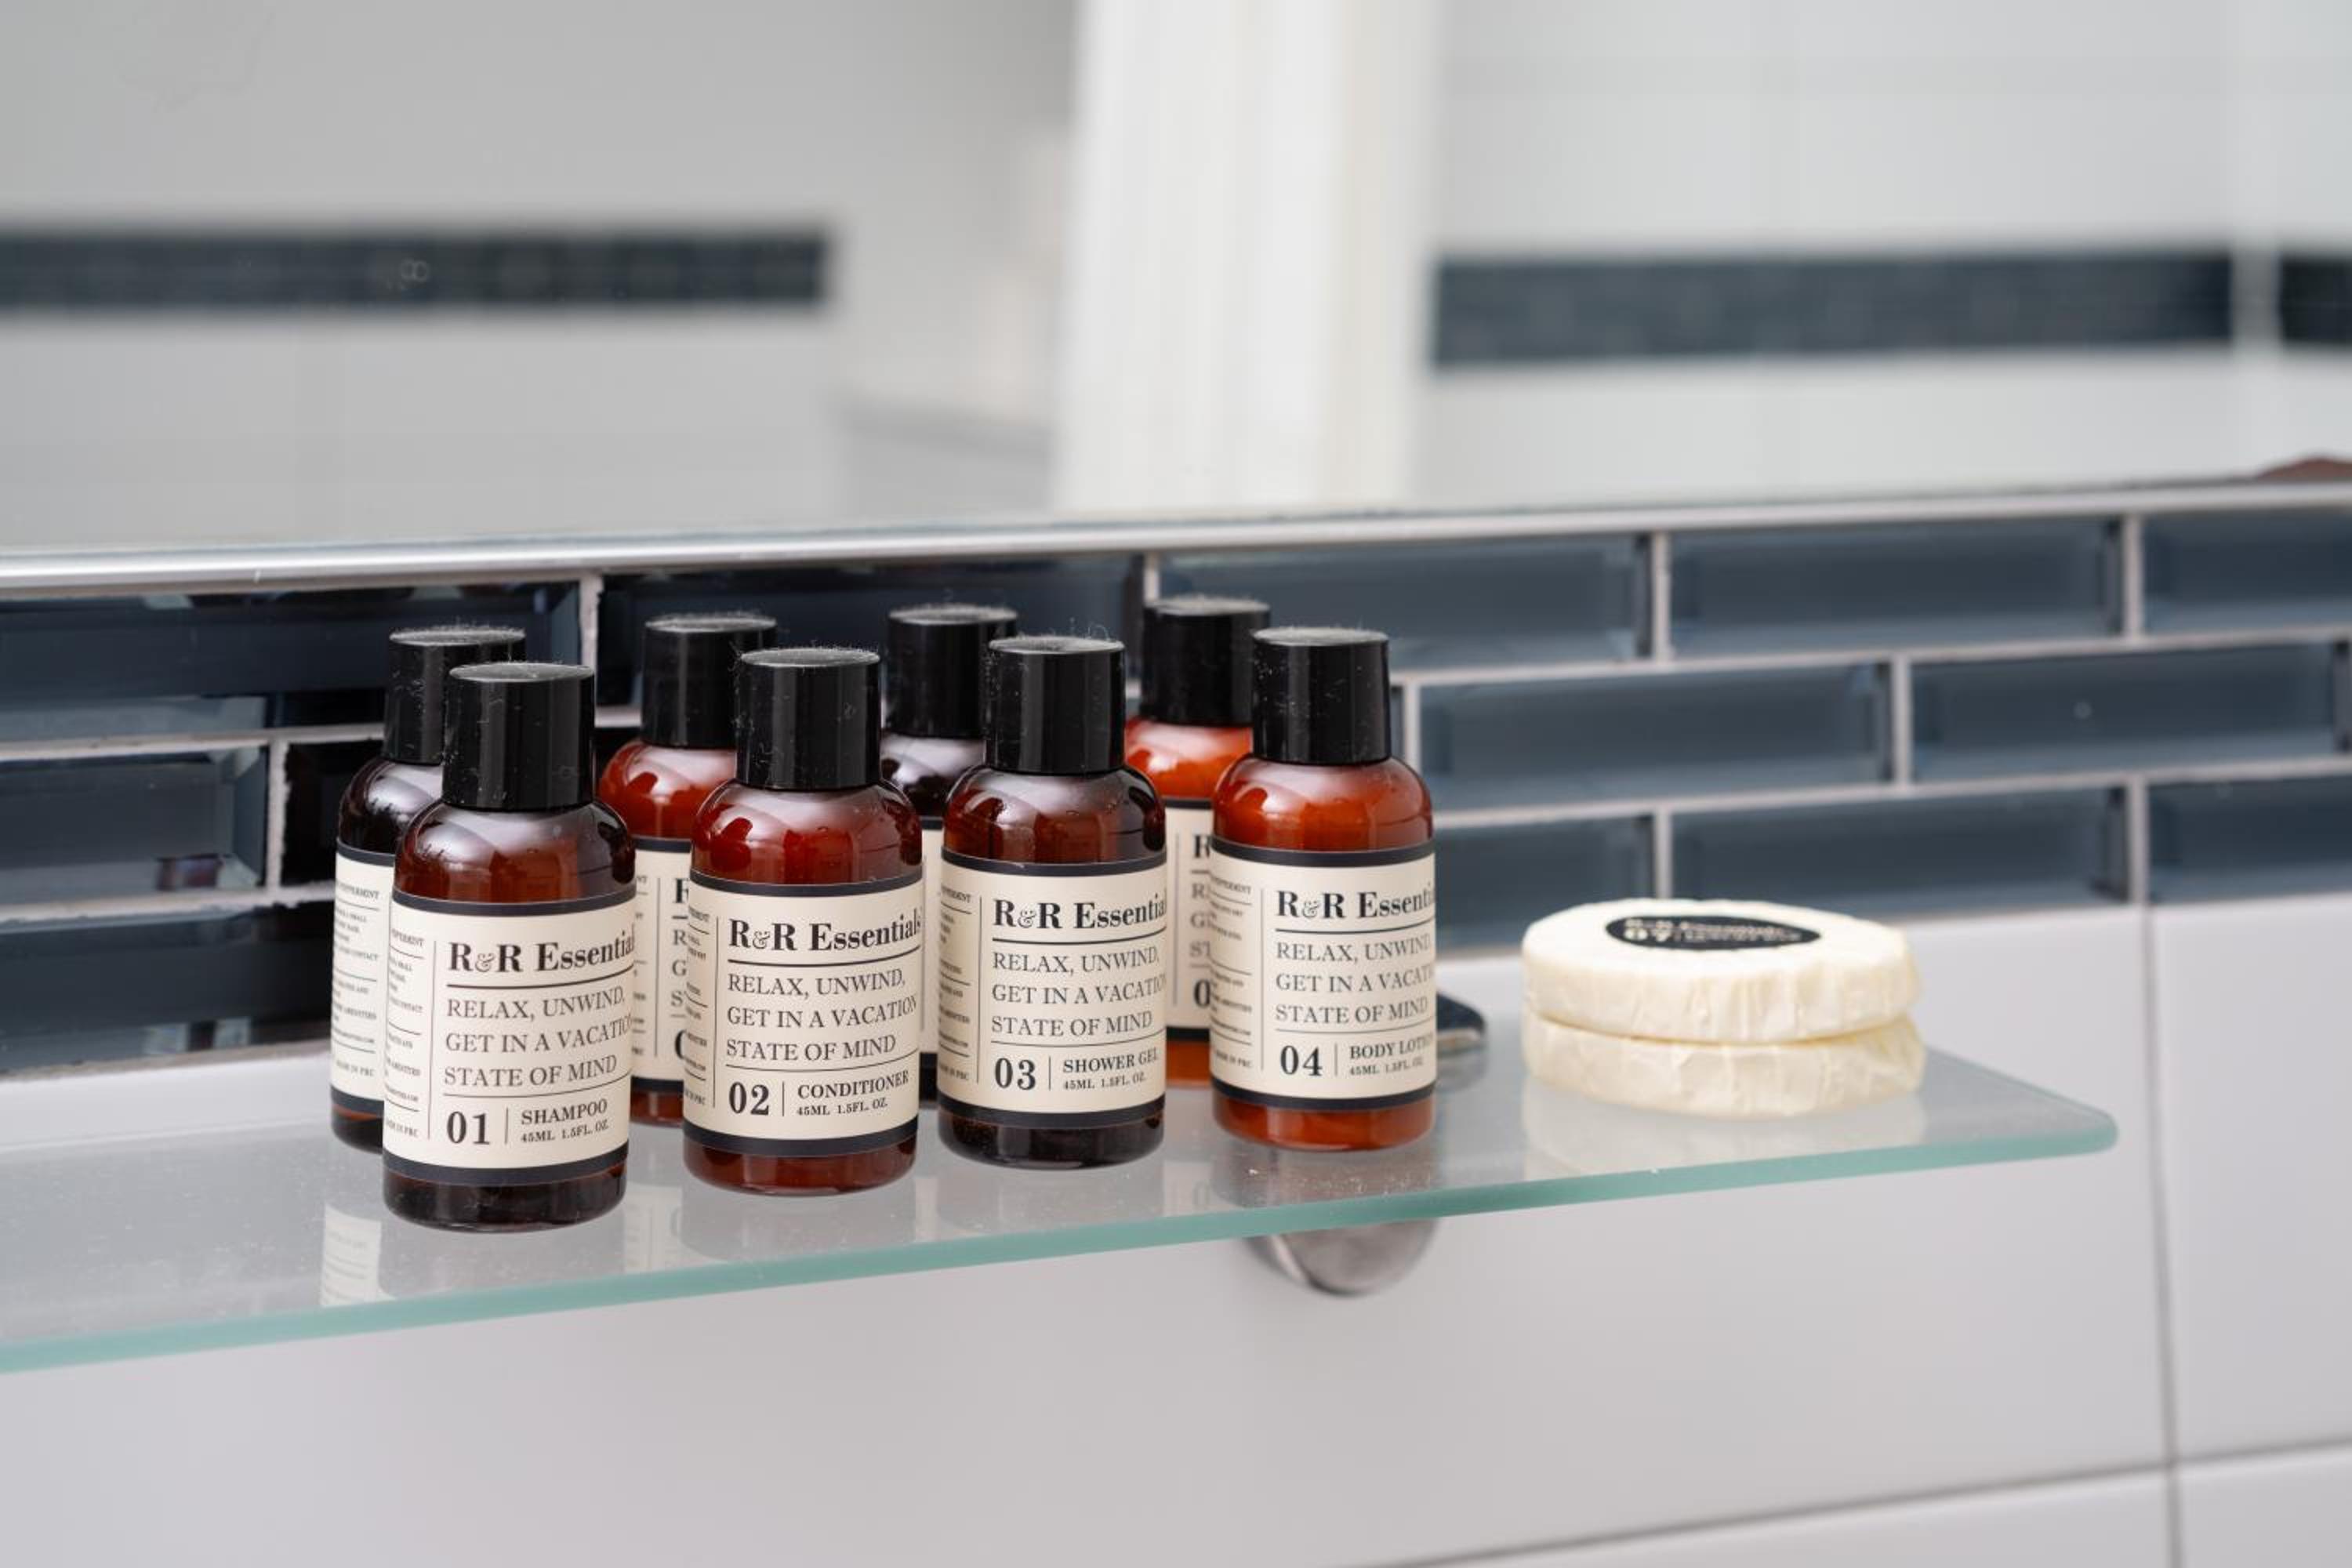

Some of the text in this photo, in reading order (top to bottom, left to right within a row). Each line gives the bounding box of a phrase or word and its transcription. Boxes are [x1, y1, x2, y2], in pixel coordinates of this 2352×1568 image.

[993, 898, 1064, 929] R&R
[1276, 890, 1347, 919] R&R
[728, 918, 798, 951] R&R
[448, 941, 523, 972] R&R
[992, 951, 1074, 976] RELAX,
[1276, 942, 1359, 964] RELAX,
[727, 973, 809, 999] RELAX,
[992, 983, 1037, 1004] GET
[1044, 987, 1068, 1004] IN
[1073, 986, 1089, 1004] A
[1275, 972, 1323, 993] GET
[1329, 975, 1352, 993] IN
[1359, 975, 1374, 993] A
[446, 998, 535, 1022] RELAX,
[727, 1006, 771, 1028] GET
[777, 1010, 804, 1028] IN
[809, 1010, 825, 1028] A
[831, 993, 917, 1026] VACATION
[991, 1010, 1152, 1036] STATE OF MIND
[1275, 996, 1428, 1025] STATE OF MIND
[445, 1032, 495, 1052] GET
[502, 1033, 528, 1052] IN
[535, 1032, 550, 1051] A
[726, 1033, 896, 1061] STATE OF MIND
[1348, 1042, 1397, 1061] BODY
[444, 1065, 524, 1087] STATE
[529, 1065, 562, 1087] OF
[567, 1054, 617, 1082] MIND
[994, 1057, 1036, 1091] 03
[1062, 1047, 1158, 1073] SHOWER GEL
[1279, 1044, 1323, 1077] 04
[797, 1069, 909, 1099] CONDITIONER
[520, 1098, 608, 1126] SHAMPOO
[728, 1081, 770, 1116] 02
[796, 1104, 831, 1116] 45ML
[446, 1110, 491, 1145] 01
[520, 1129, 555, 1143] 45ML
